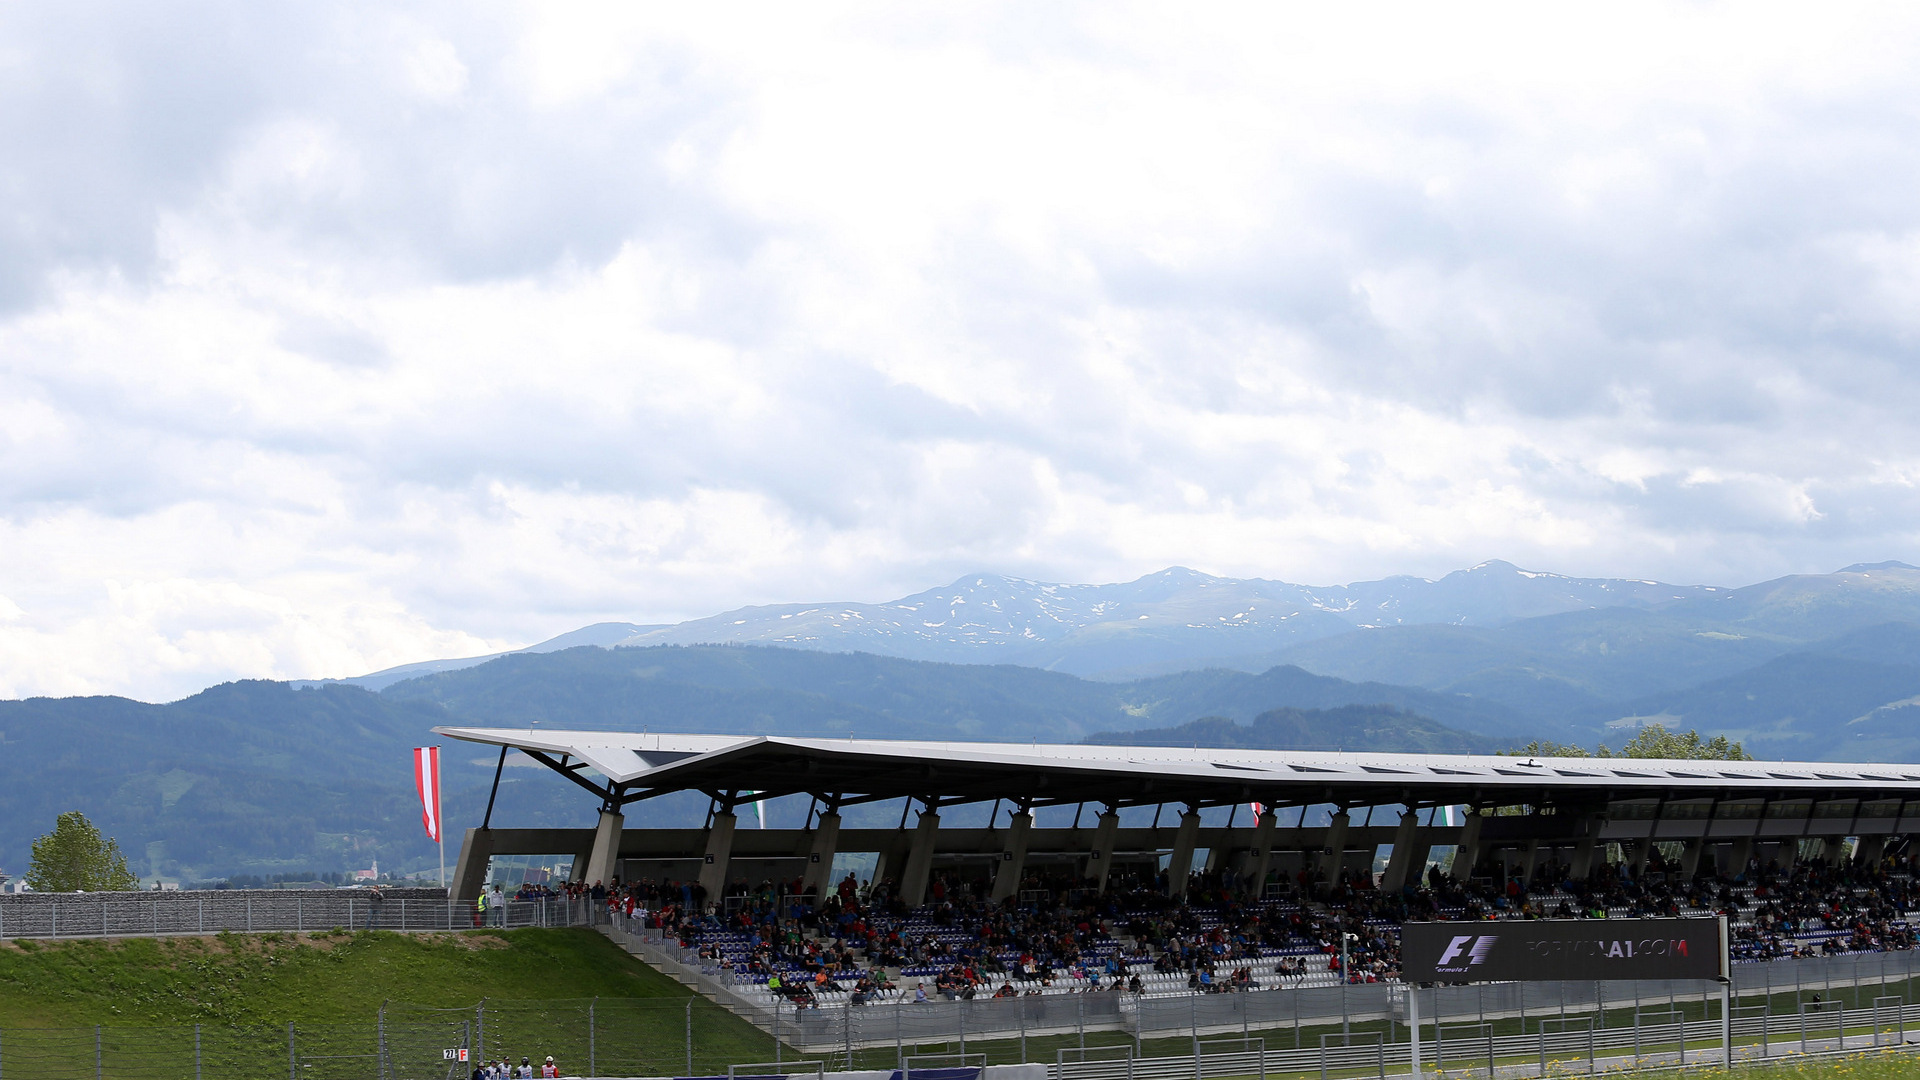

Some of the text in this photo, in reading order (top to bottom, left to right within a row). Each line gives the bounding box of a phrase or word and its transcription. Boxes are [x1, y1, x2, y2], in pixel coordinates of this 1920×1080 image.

[1437, 935, 1500, 965] F1
[1525, 939, 1689, 958] OLA1.COM
[460, 1049, 467, 1061] F
